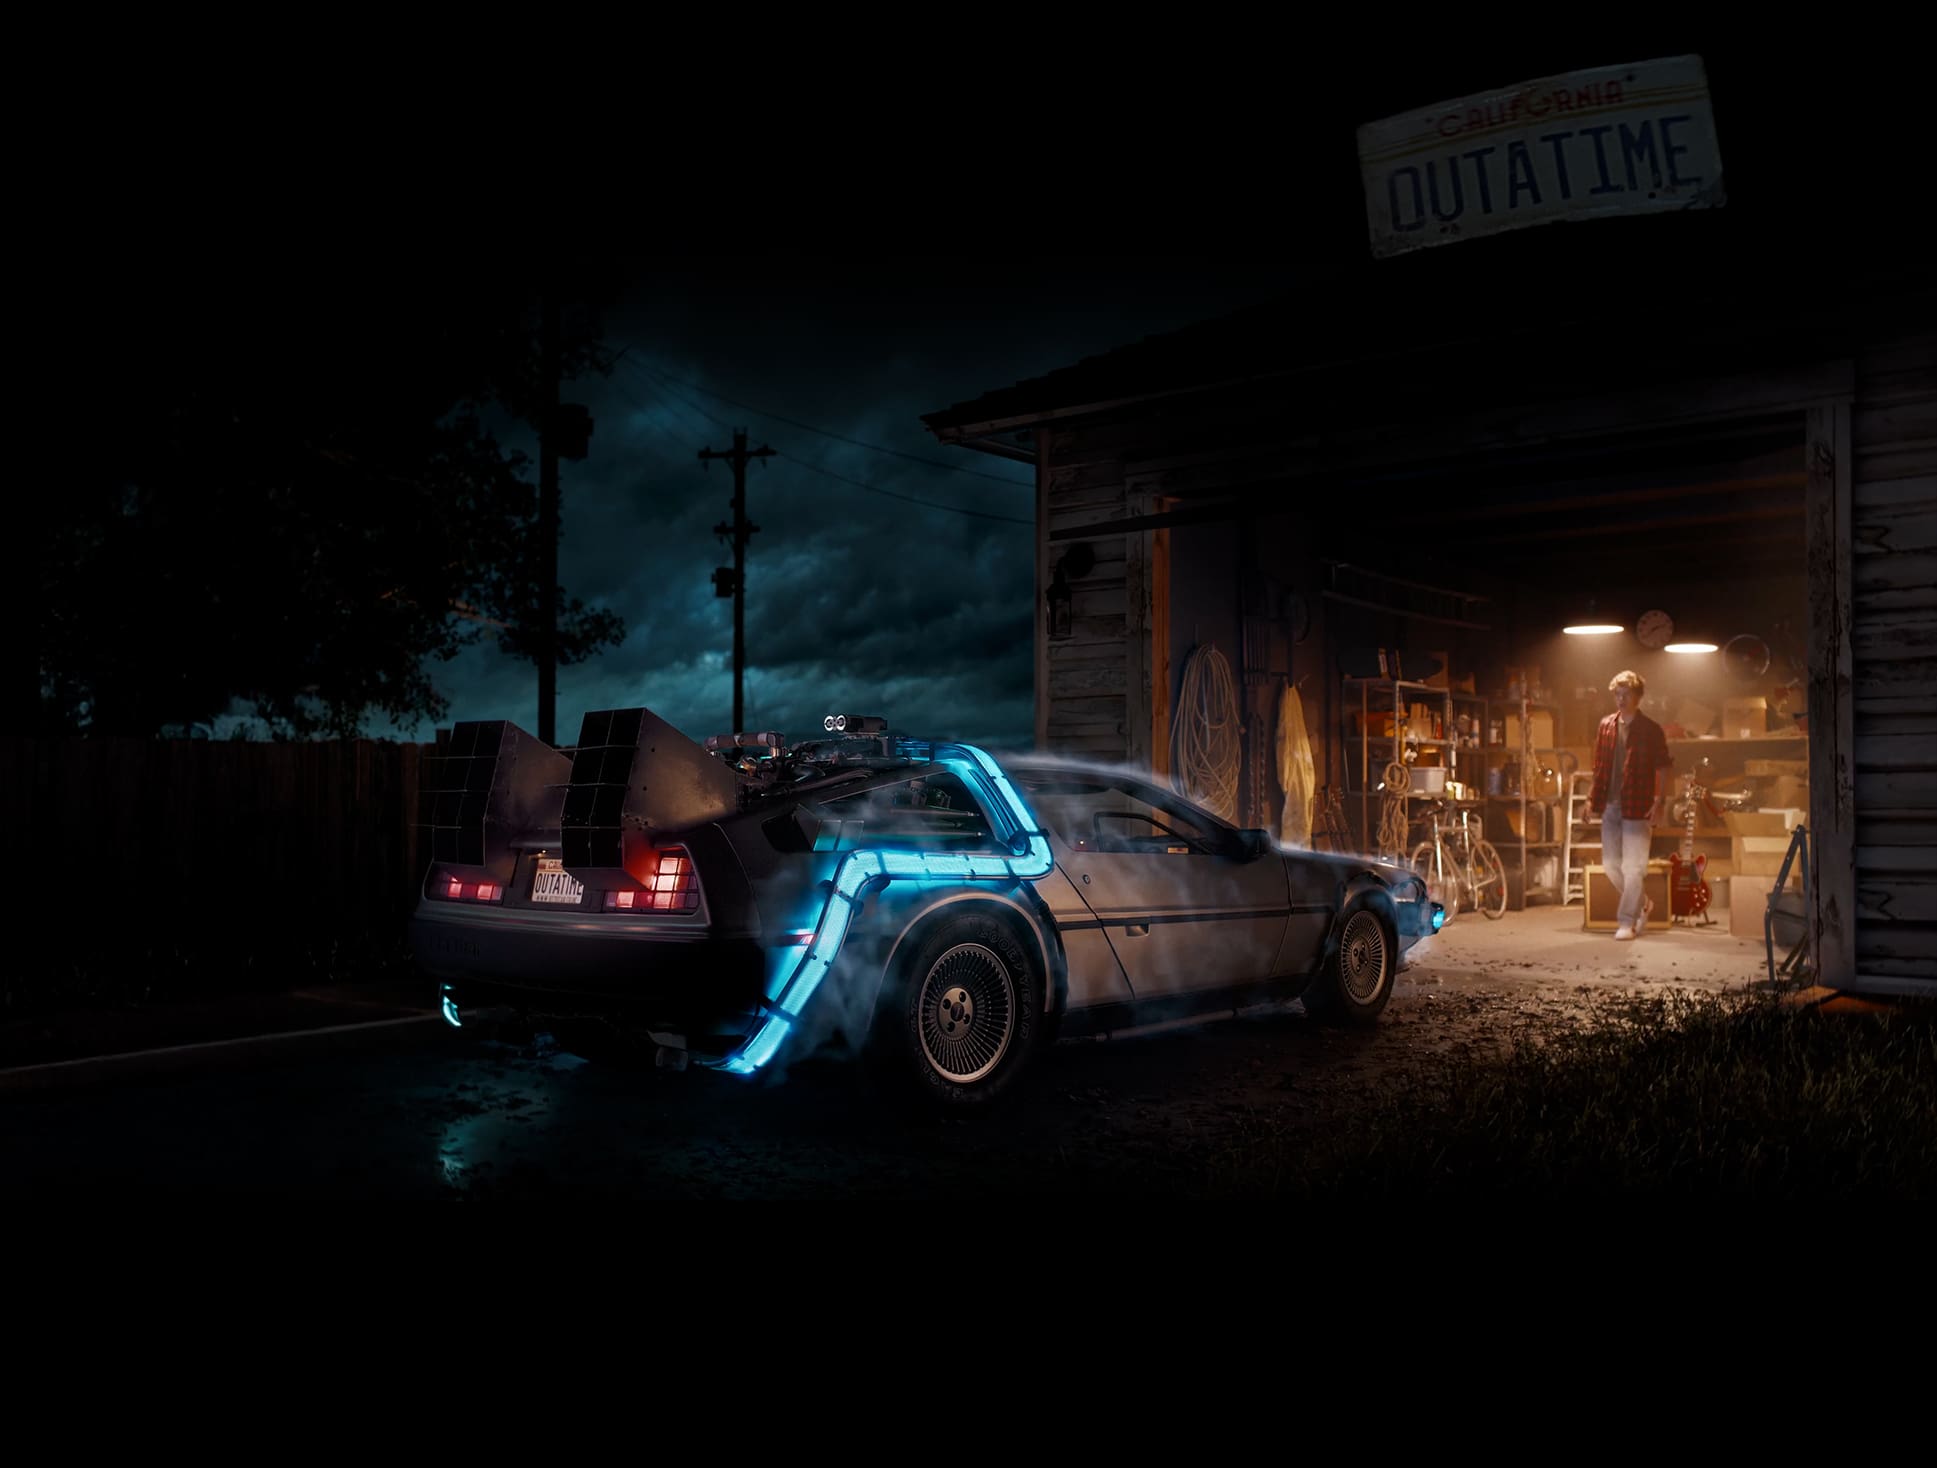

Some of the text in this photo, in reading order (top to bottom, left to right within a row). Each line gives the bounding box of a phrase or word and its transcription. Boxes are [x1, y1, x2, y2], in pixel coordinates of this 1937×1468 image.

[1436, 80, 1624, 137] CALIFORNIA
[1388, 115, 1703, 233] OUTATIME
[535, 872, 583, 896] OUTATIME
